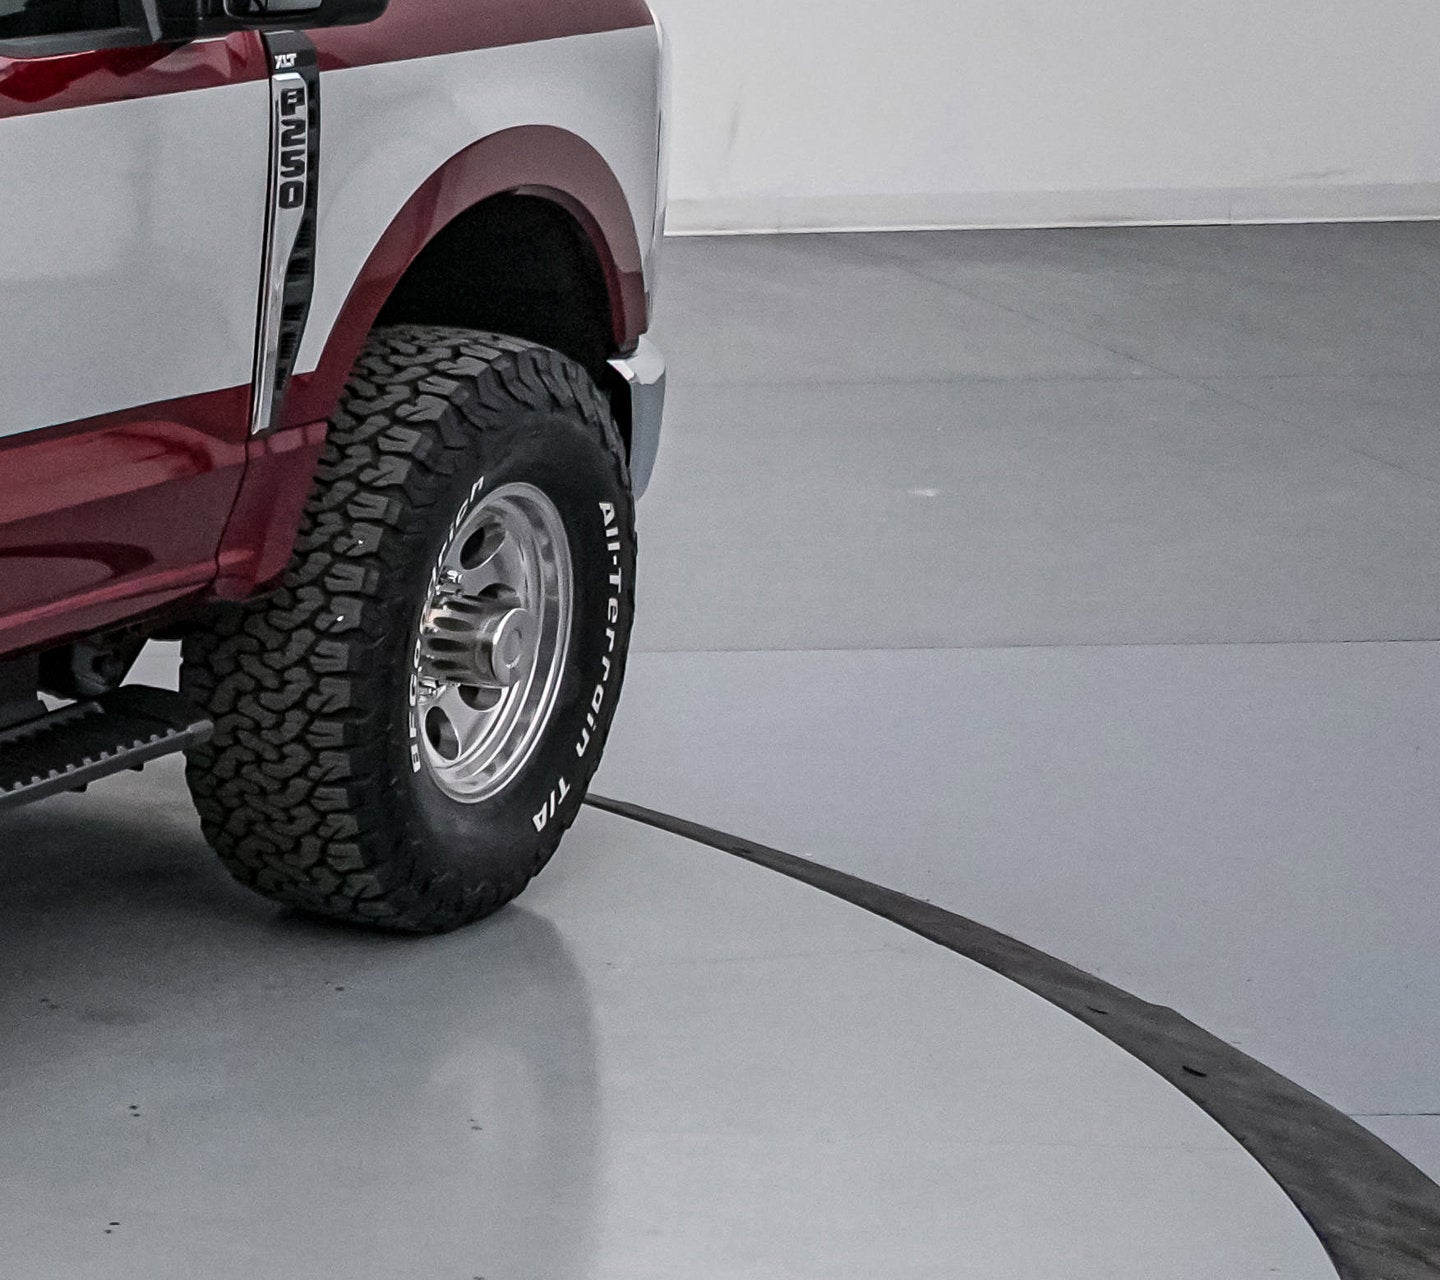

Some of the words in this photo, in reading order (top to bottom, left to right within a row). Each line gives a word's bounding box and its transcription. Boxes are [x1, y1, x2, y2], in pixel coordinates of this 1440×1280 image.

[274, 52, 297, 70] XLT
[278, 87, 306, 209] F250
[575, 501, 621, 757] All-Terrain
[532, 776, 571, 832] T/A
